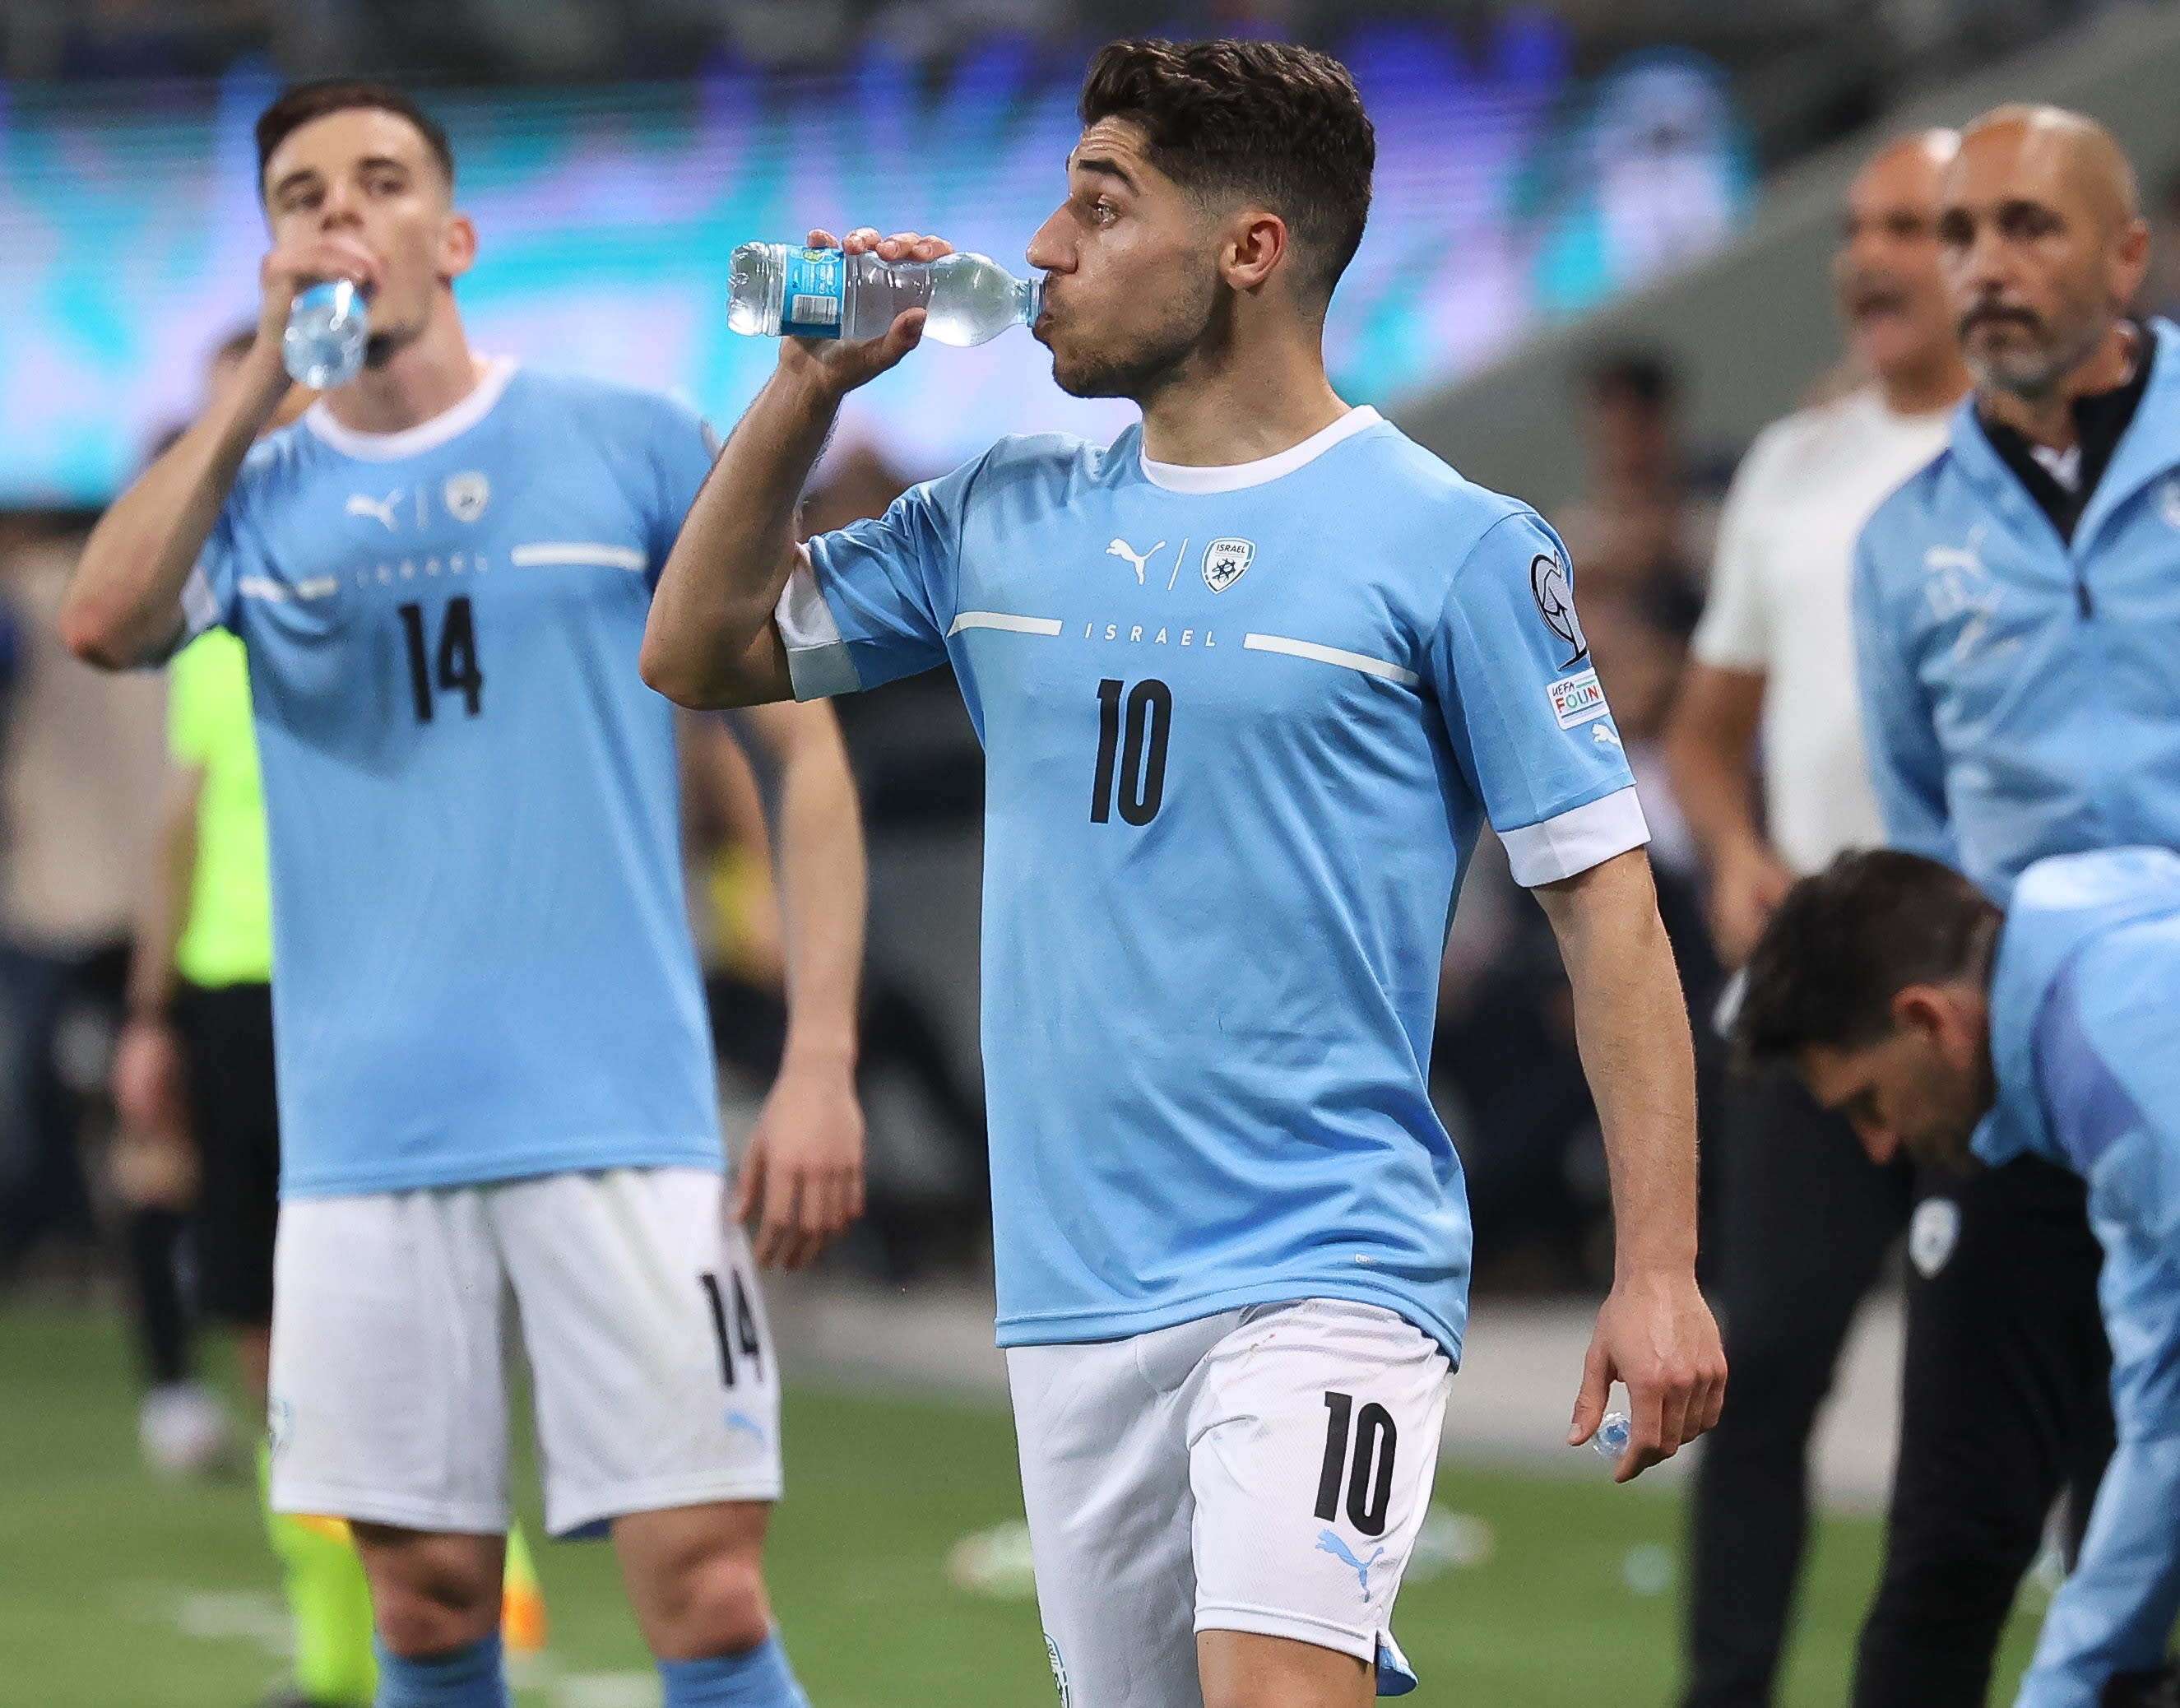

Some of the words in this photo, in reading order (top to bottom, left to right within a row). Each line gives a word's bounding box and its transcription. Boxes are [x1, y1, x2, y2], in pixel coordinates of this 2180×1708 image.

[1216, 544, 1245, 554] ISRAEL
[398, 595, 483, 723] 14
[1084, 622, 1216, 647] ISRAEL
[1552, 680, 1575, 697] UEFA
[1090, 679, 1172, 826] 10
[700, 1267, 763, 1387] 14
[1314, 1390, 1397, 1537] 10
